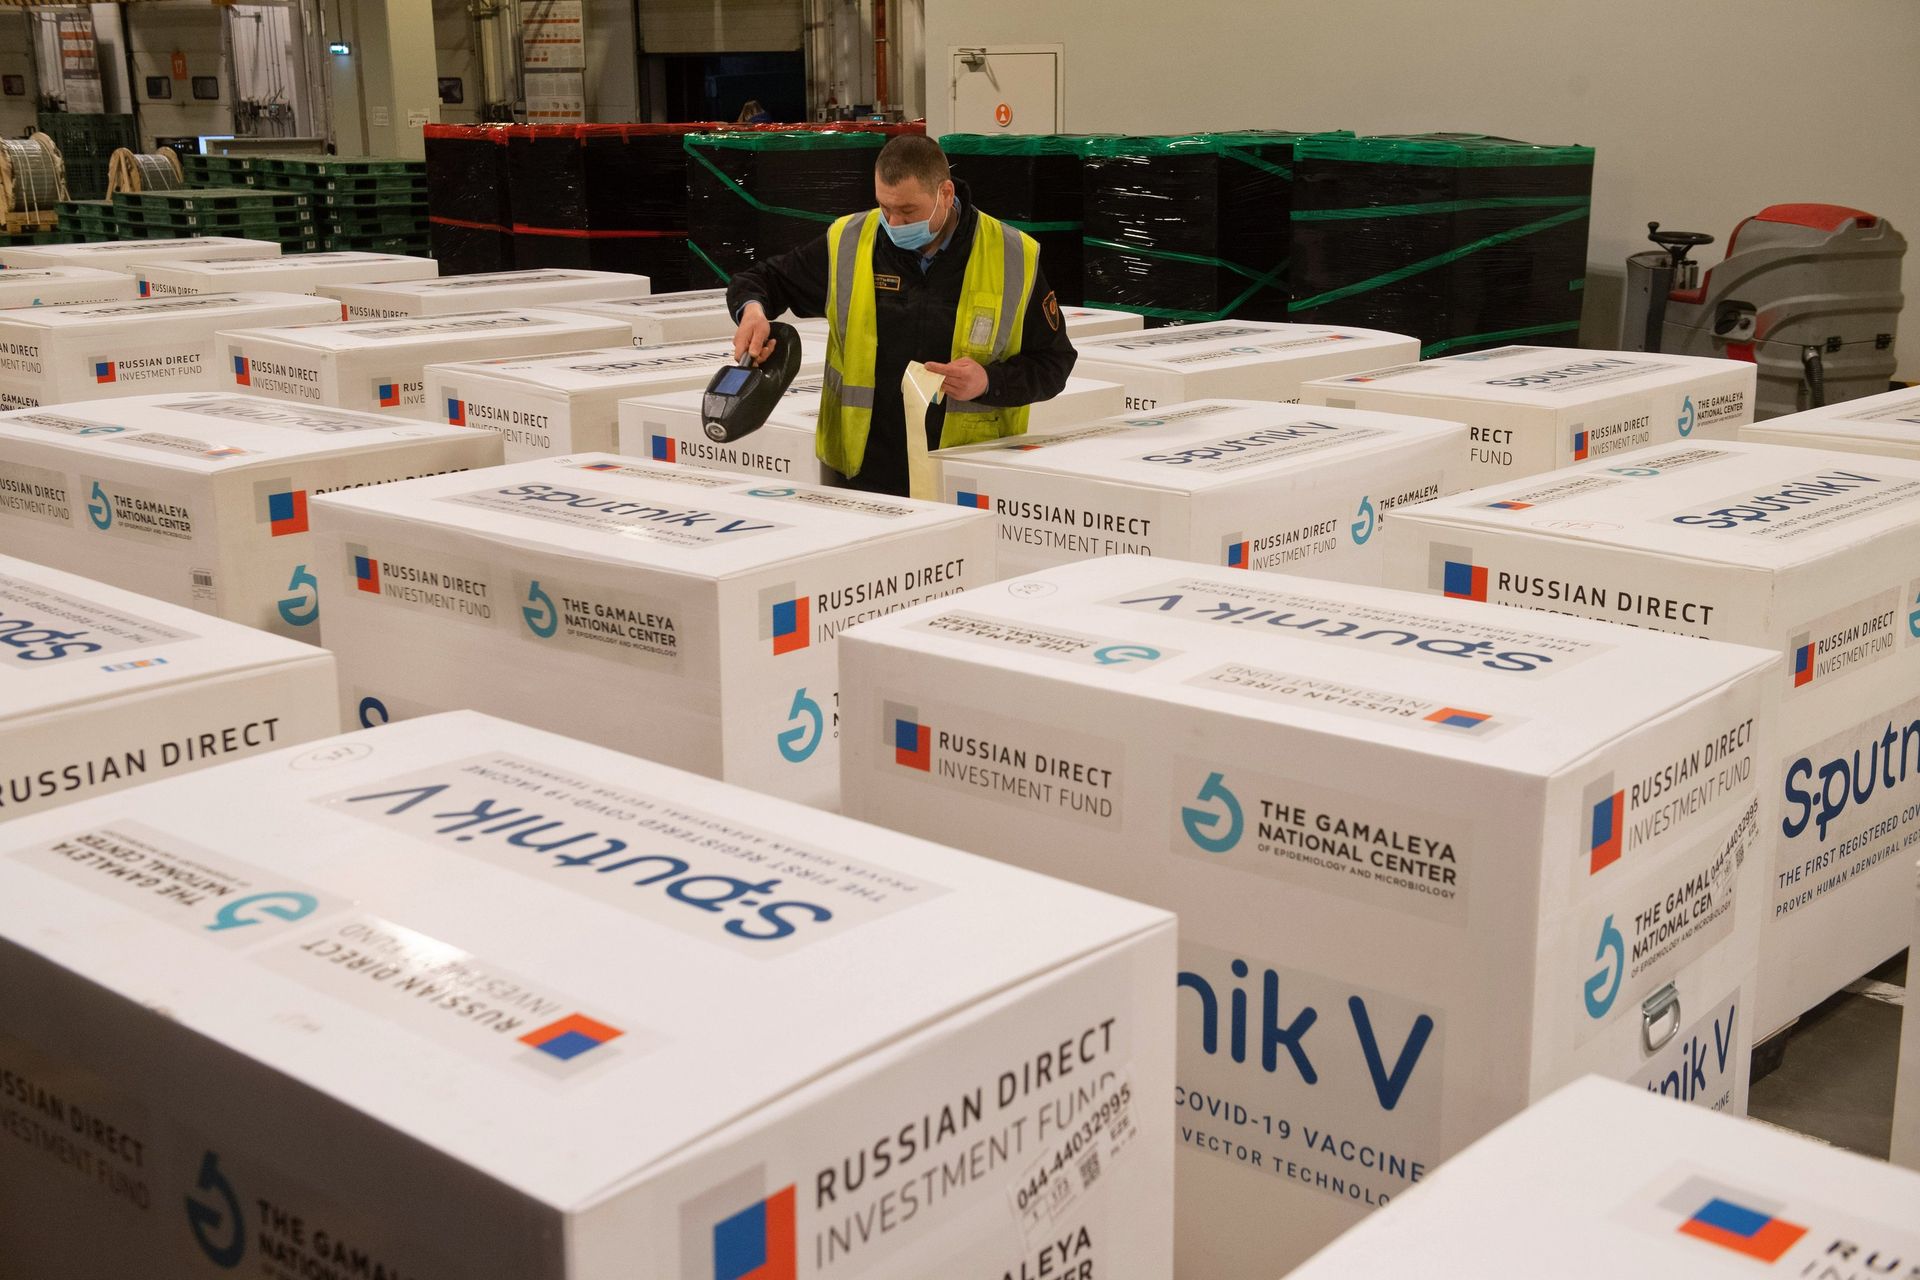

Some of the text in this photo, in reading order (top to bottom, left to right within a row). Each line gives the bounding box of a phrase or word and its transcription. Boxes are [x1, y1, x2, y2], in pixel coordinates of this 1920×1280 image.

[152, 283, 177, 294] RUSSIAN
[350, 306, 380, 318] RUSSIAN
[10, 344, 39, 358] DIRECT
[119, 354, 200, 369] RUSSIAN DIRECT
[22, 362, 41, 374] FUND
[120, 366, 202, 381] INVESTMENT FUND
[252, 360, 318, 382] RUSSIAN DIRECT
[2, 393, 39, 408] GAMALEYA
[1697, 408, 1722, 420] NATIONAL
[1724, 402, 1743, 414] CENTER
[1698, 391, 1743, 409] THE GAMALEYA
[468, 403, 509, 422] RUSSIAN
[513, 411, 548, 430] DIRECT
[1591, 415, 1649, 441] RUSSIAN DIRECT
[526, 434, 550, 449] FUND
[681, 440, 791, 474] RUSSIAN DIRECT
[1470, 448, 1513, 466] FUND
[1590, 432, 1649, 456] INVESTMENT FUND
[35, 485, 65, 502] DIRECT
[114, 494, 189, 519] THE GAMALEYA
[1380, 498, 1395, 511] THE
[1398, 484, 1438, 505] GAMALEYA
[48, 504, 70, 520] FUND
[116, 509, 157, 525] NATIONAL
[159, 517, 191, 532] CENTER
[997, 499, 1150, 537] RUSSIAN DIRECT
[998, 523, 1099, 555] INVESTMENT
[1254, 519, 1337, 552] RUSSIAN DIRECT
[1253, 538, 1336, 571] INVESTMENT FUND
[383, 562, 487, 598] RUSSIAN DIRECT
[818, 558, 964, 613] RUSSIAN DIRECT
[1177, 584, 1250, 600] VACCINE
[384, 583, 491, 619] INVESTMENT FUND
[562, 597, 675, 632] THE GAMALEYA
[1119, 594, 1184, 611] V
[1499, 572, 1606, 607] RUSSIAN
[1617, 592, 1713, 625] DIRECT
[565, 614, 676, 647] NATIONAL CENTER
[928, 621, 1032, 645] GAMALEYA
[937, 617, 1002, 632] CENTER
[1007, 629, 1090, 648] NATIONAL
[1347, 611, 1465, 634] REGISTERED
[1473, 632, 1530, 645] FIRST
[1818, 610, 1894, 655] RUSSIAN DIRECT
[1034, 641, 1076, 653] THE
[1538, 642, 1576, 652] THE
[1816, 632, 1893, 679] INVESTMENT FUND
[1209, 673, 1418, 718] RUSSIAN DIRECT
[1225, 666, 1433, 711] INVESTMENT FUND
[161, 717, 280, 768] DIRECT
[939, 731, 1112, 789] RUSSIAN DIRECT
[1631, 718, 1753, 811] RUSSIAN DIRECT
[459, 764, 541, 793] VACCINE
[939, 758, 1113, 818] INVESTMENT FUND
[346, 784, 451, 815] V
[1628, 777, 1715, 851] INVESTMENT
[1718, 756, 1751, 797] FUND
[76, 833, 145, 862] CENTER
[639, 818, 771, 865] REGISTERED
[1260, 800, 1456, 863] THE GAMALEYA
[50, 842, 162, 888] GAMALEYA
[769, 840, 834, 867] HUMAN
[1258, 822, 1456, 886] NATIONAL CENTER
[1779, 816, 1899, 889] THE FIRST REGISTERED
[148, 860, 235, 896] NATIONAL
[768, 858, 836, 887] FIRST
[841, 864, 918, 893] PROVEN
[1258, 844, 1455, 900] OF EPIDEMIOLOGY AND MICROBIOLOGY
[1776, 841, 1900, 917] PROVEN HUMAN ADENOVIRAL
[156, 884, 205, 907] THE
[838, 883, 887, 903] THE
[1632, 910, 1689, 963] NATIONAL
[1635, 906, 1661, 936] THE
[300, 938, 401, 981] DIRECT
[394, 975, 526, 1034] RUSSIAN
[1348, 995, 1434, 1111] V
[1714, 1004, 1735, 1075] V
[817, 1017, 1116, 1210] RUSSIAN DIRECT
[70, 1105, 144, 1168] DIRECT
[1016, 1082, 1131, 1211] 044-44032995
[1175, 1086, 1425, 1183] COVID-19 VACCINE
[1181, 1126, 1262, 1167] VECTOR
[816, 1116, 1034, 1271] INVESTMENT
[257, 1198, 303, 1245] THE
